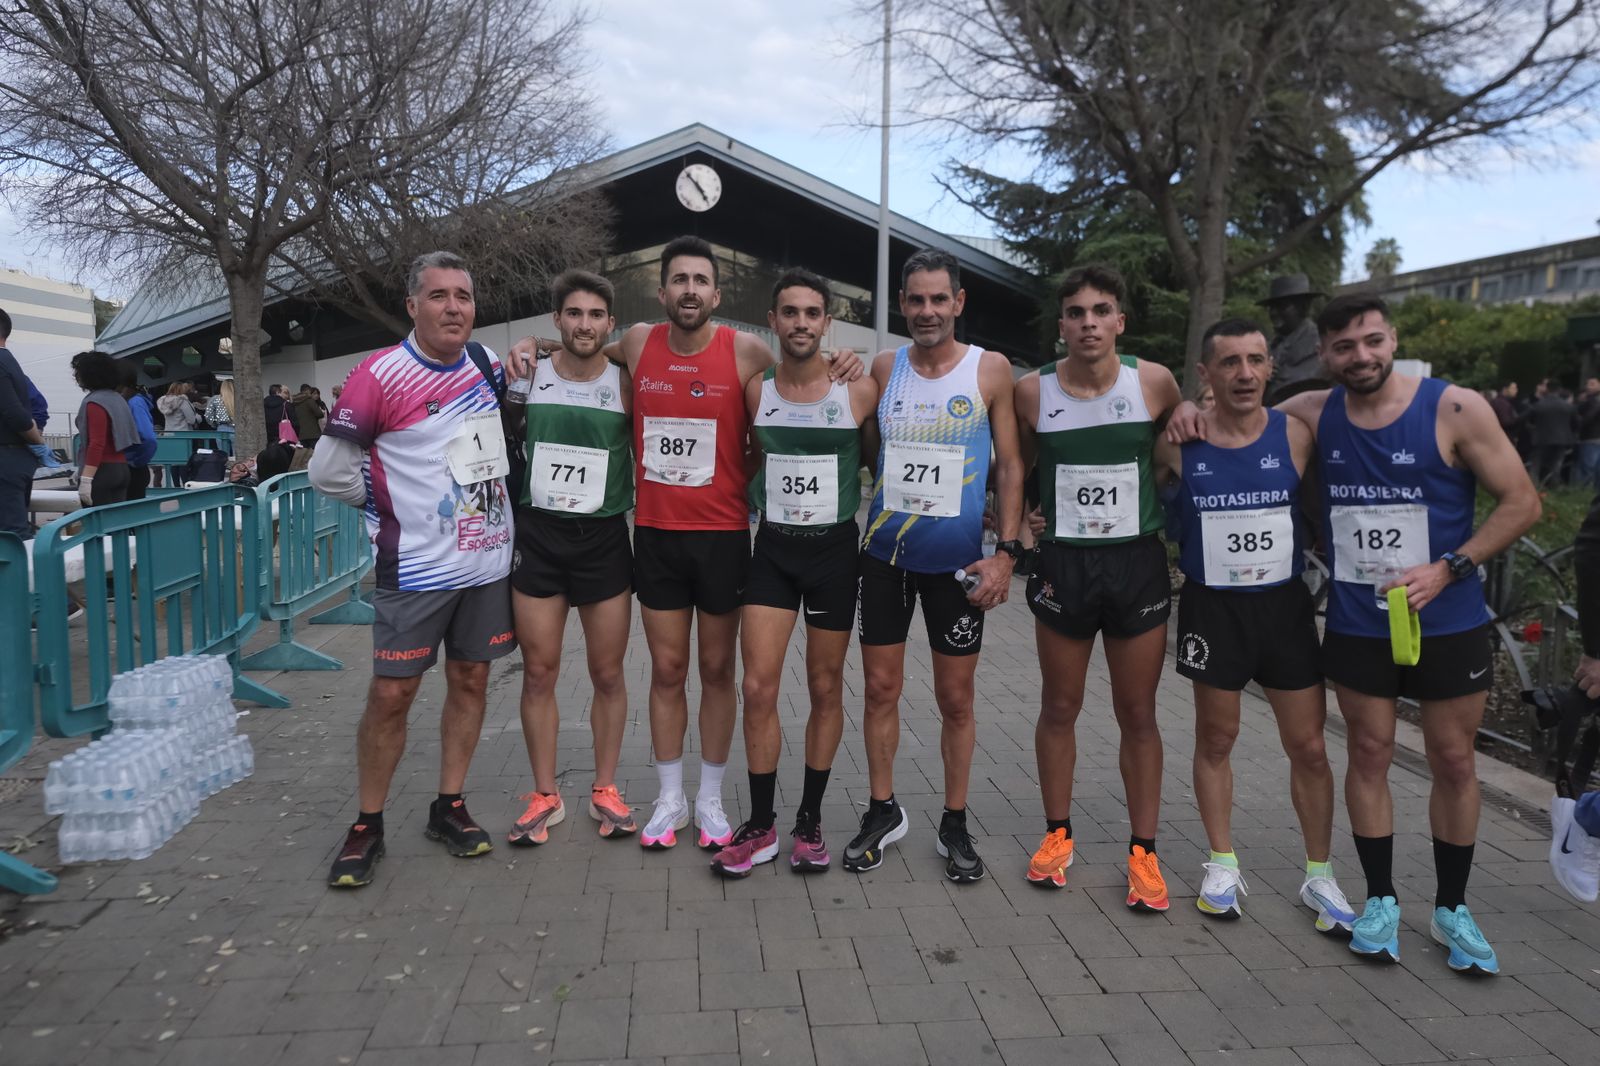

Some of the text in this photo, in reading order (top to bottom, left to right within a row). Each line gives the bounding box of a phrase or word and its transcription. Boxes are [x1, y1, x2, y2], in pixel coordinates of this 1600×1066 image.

[647, 380, 673, 392] califas
[472, 432, 482, 451] 1
[660, 437, 698, 457] 887
[550, 463, 586, 484] 771
[902, 463, 941, 485] 271
[782, 475, 819, 495] 354
[1077, 486, 1120, 506] 621
[1192, 489, 1290, 508] TROTASIERRA
[1227, 530, 1274, 553] 385
[1353, 528, 1402, 550] 182
